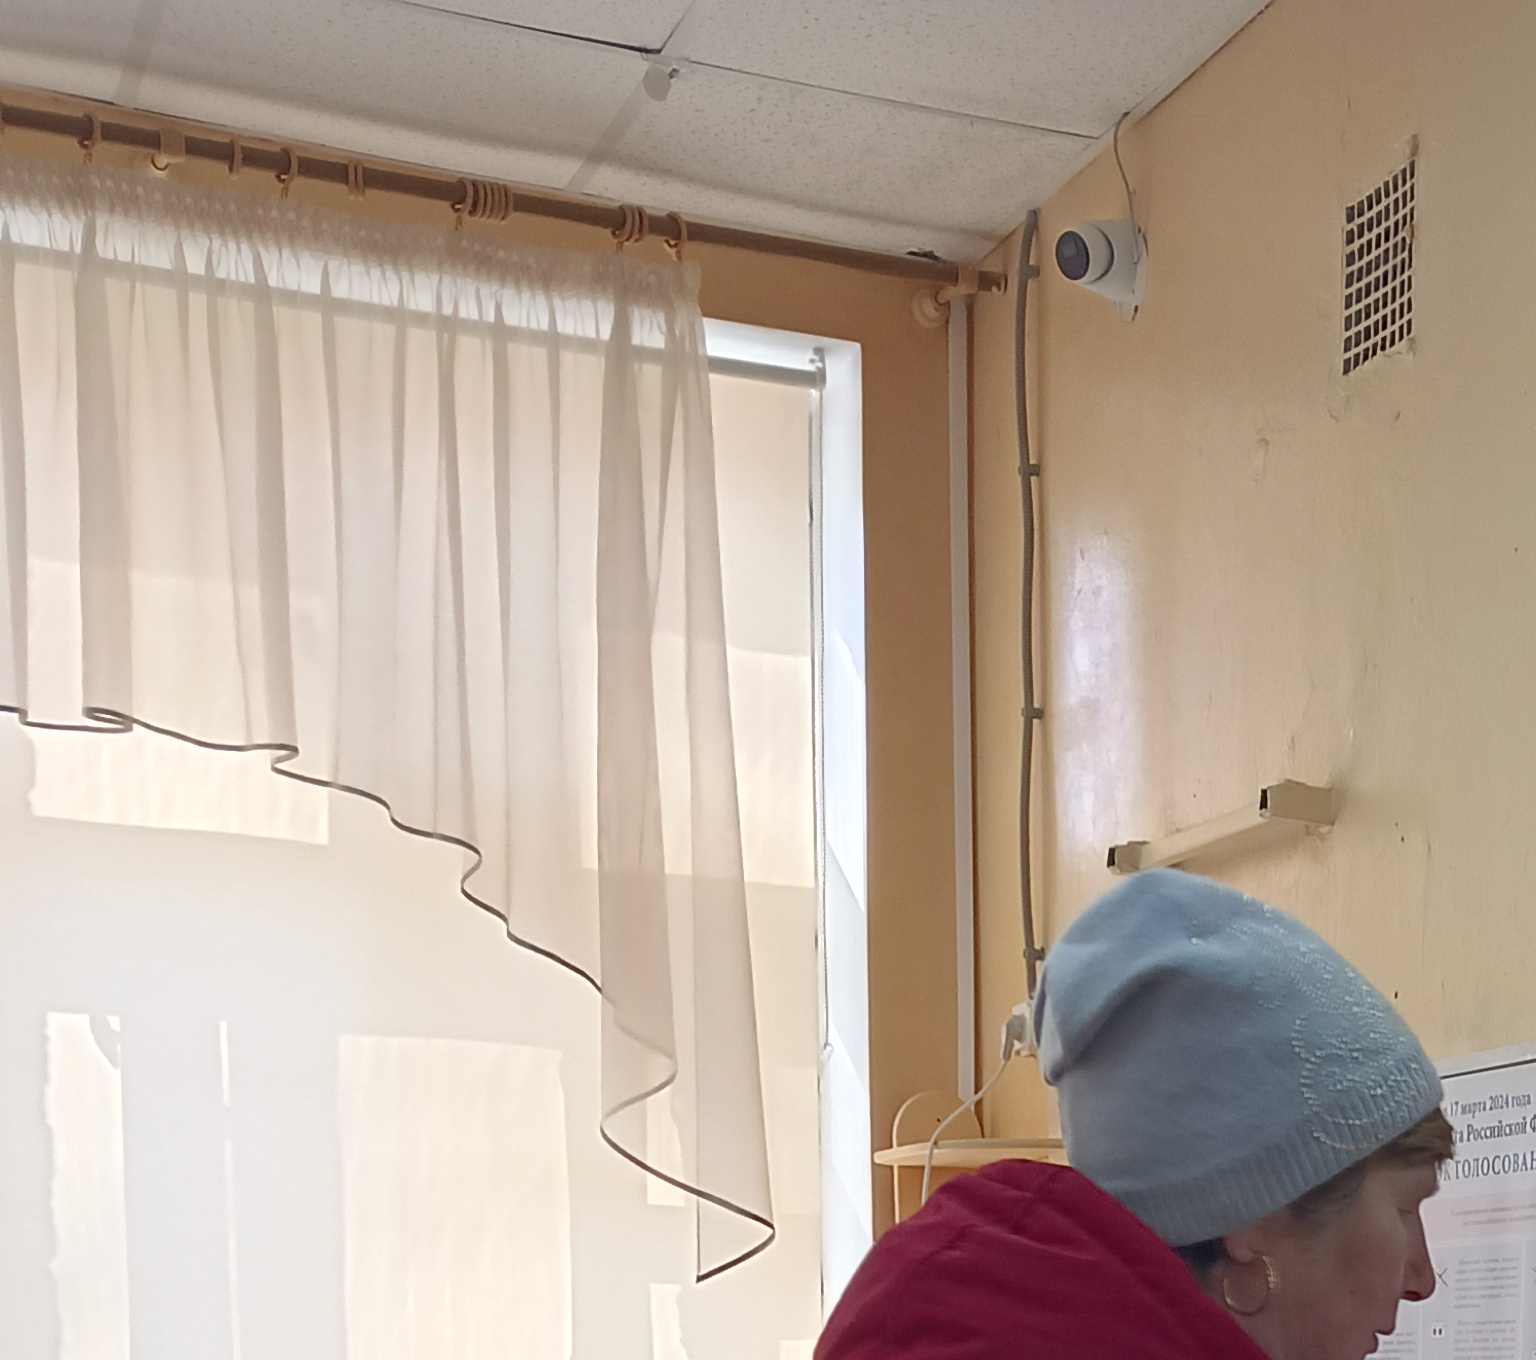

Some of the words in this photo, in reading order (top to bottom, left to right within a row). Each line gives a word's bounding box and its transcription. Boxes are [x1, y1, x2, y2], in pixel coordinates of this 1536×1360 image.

[1450, 1101, 1459, 1117] 17
[1460, 1100, 1487, 1119] марта
[1489, 1093, 1509, 1111] 2024
[1511, 1093, 1532, 1110] года
[1466, 1116, 1527, 1143] Российской
